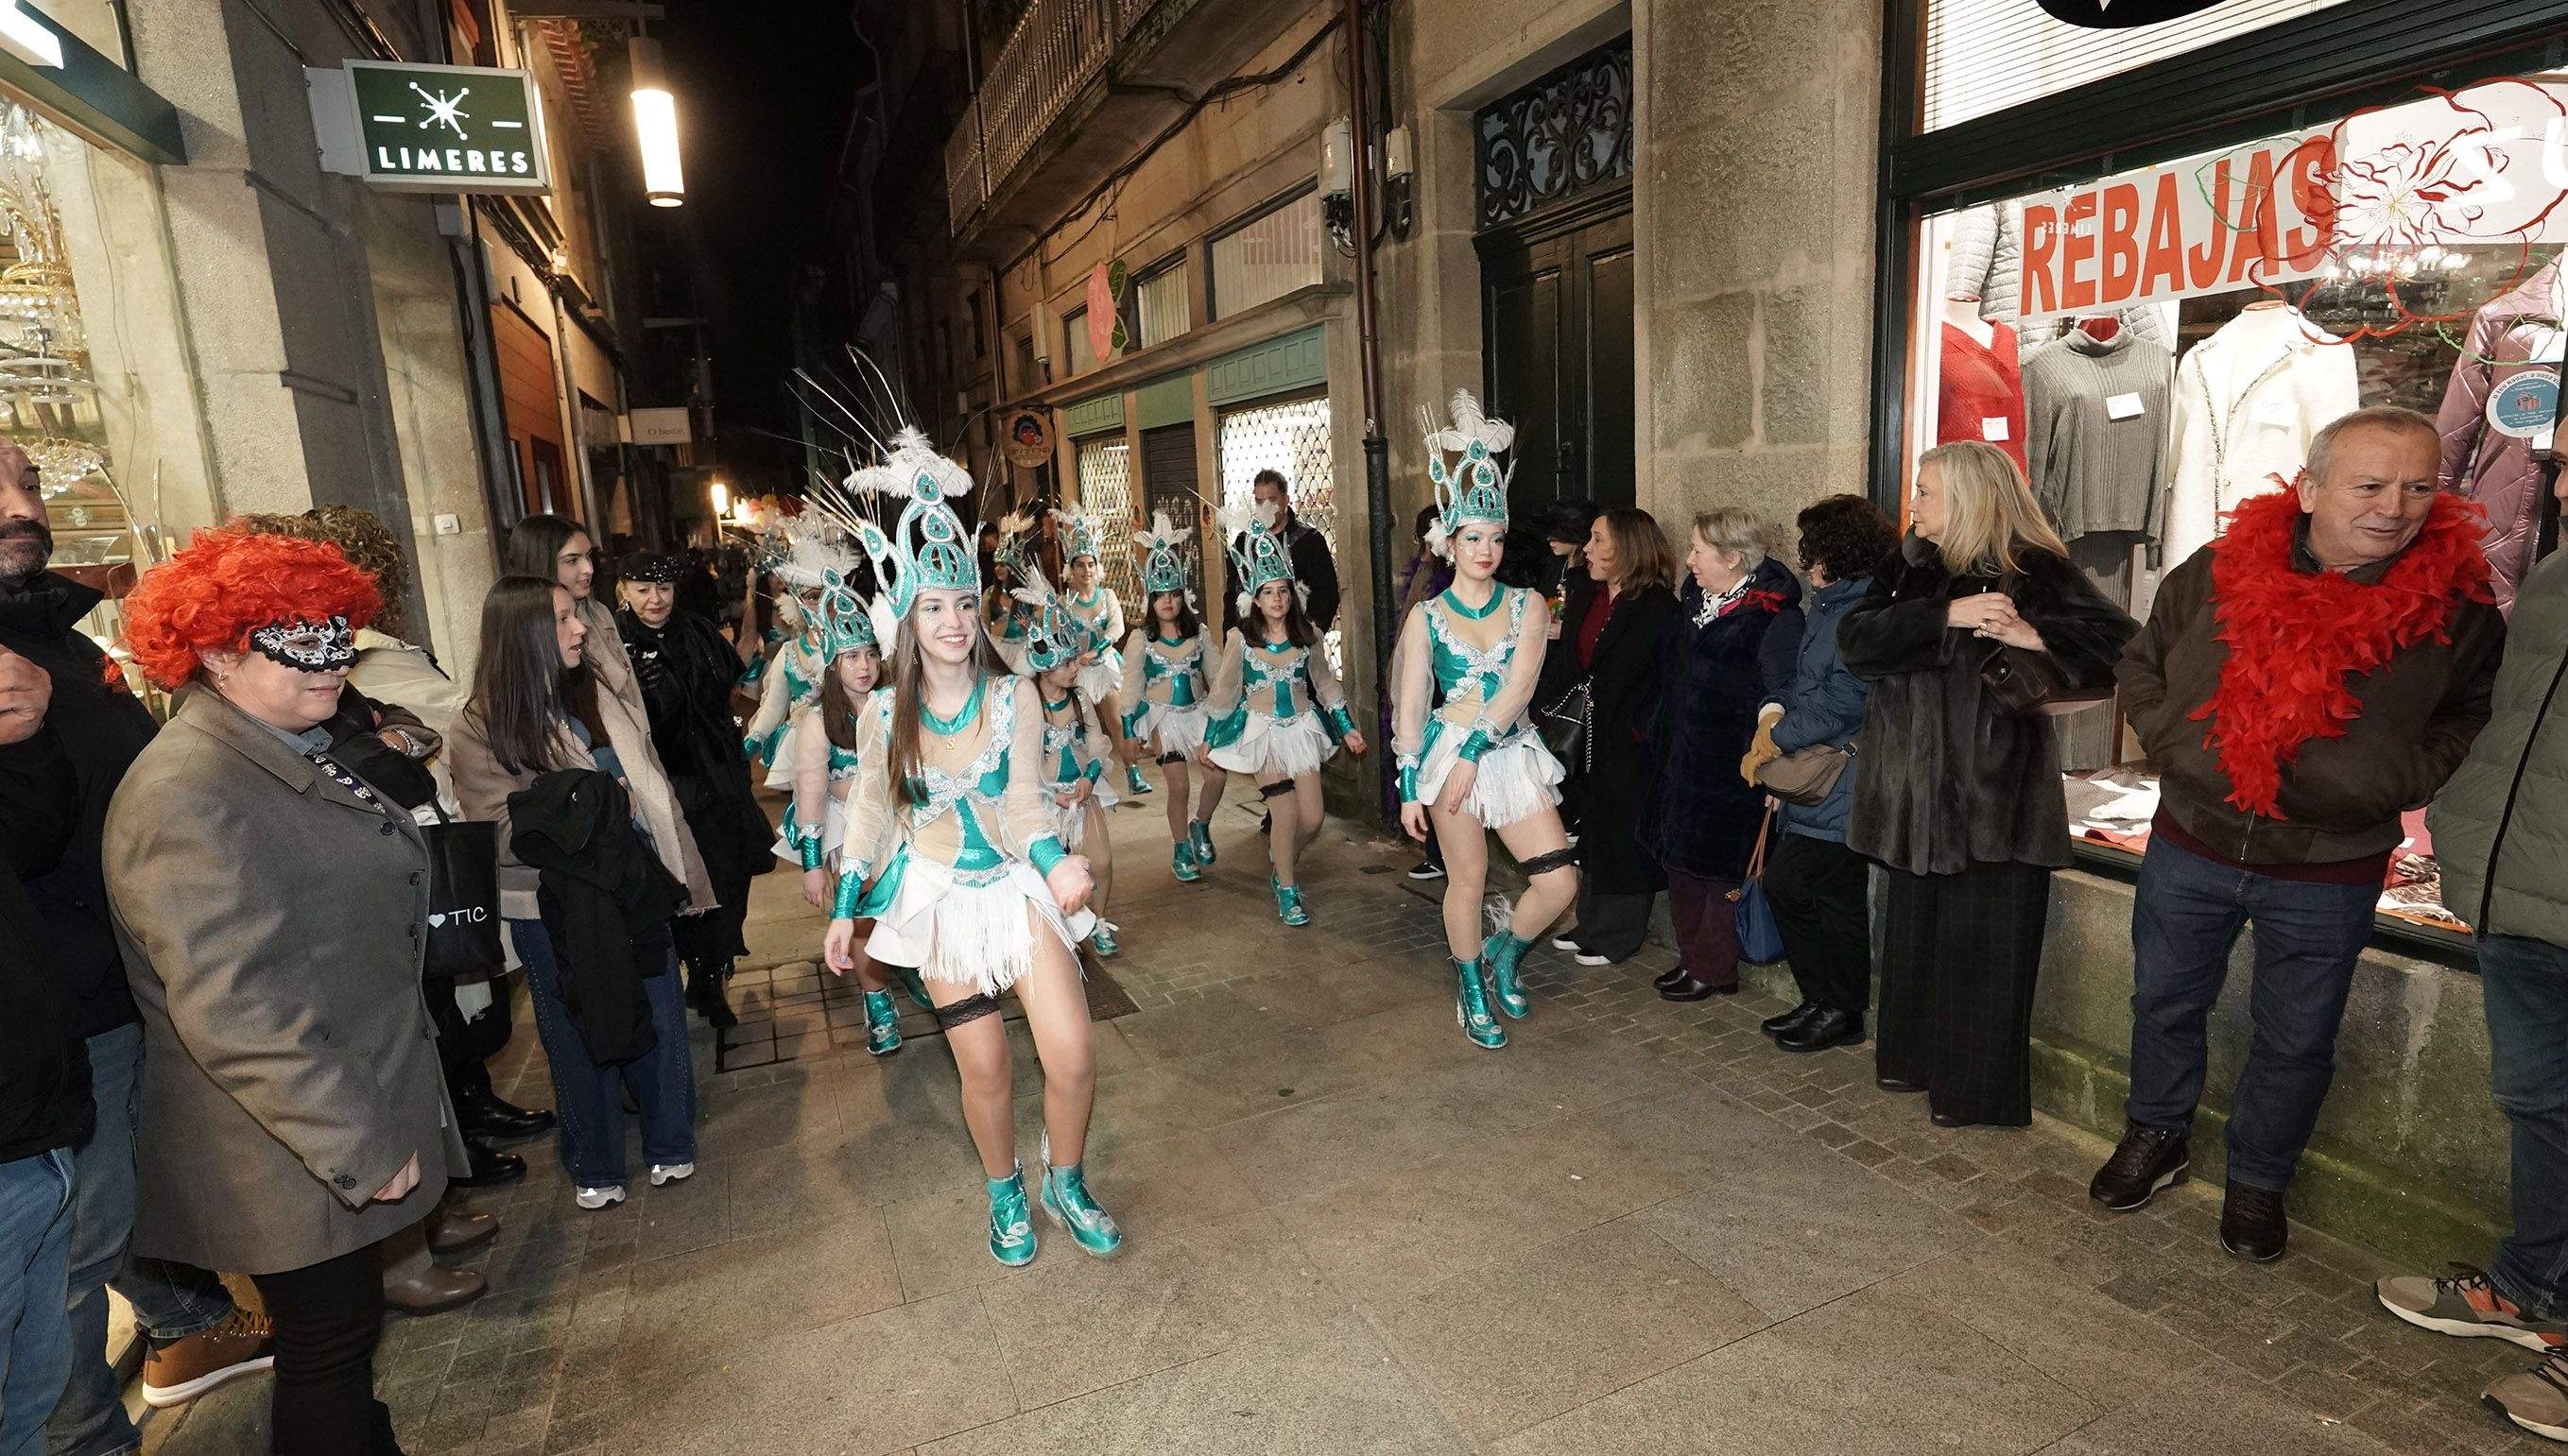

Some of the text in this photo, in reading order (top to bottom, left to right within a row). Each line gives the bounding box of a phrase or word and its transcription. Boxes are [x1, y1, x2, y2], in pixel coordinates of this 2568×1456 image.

[378, 146, 528, 174] LIMERES
[2021, 135, 2336, 316] REBAJAS
[448, 906, 488, 926] TIC
